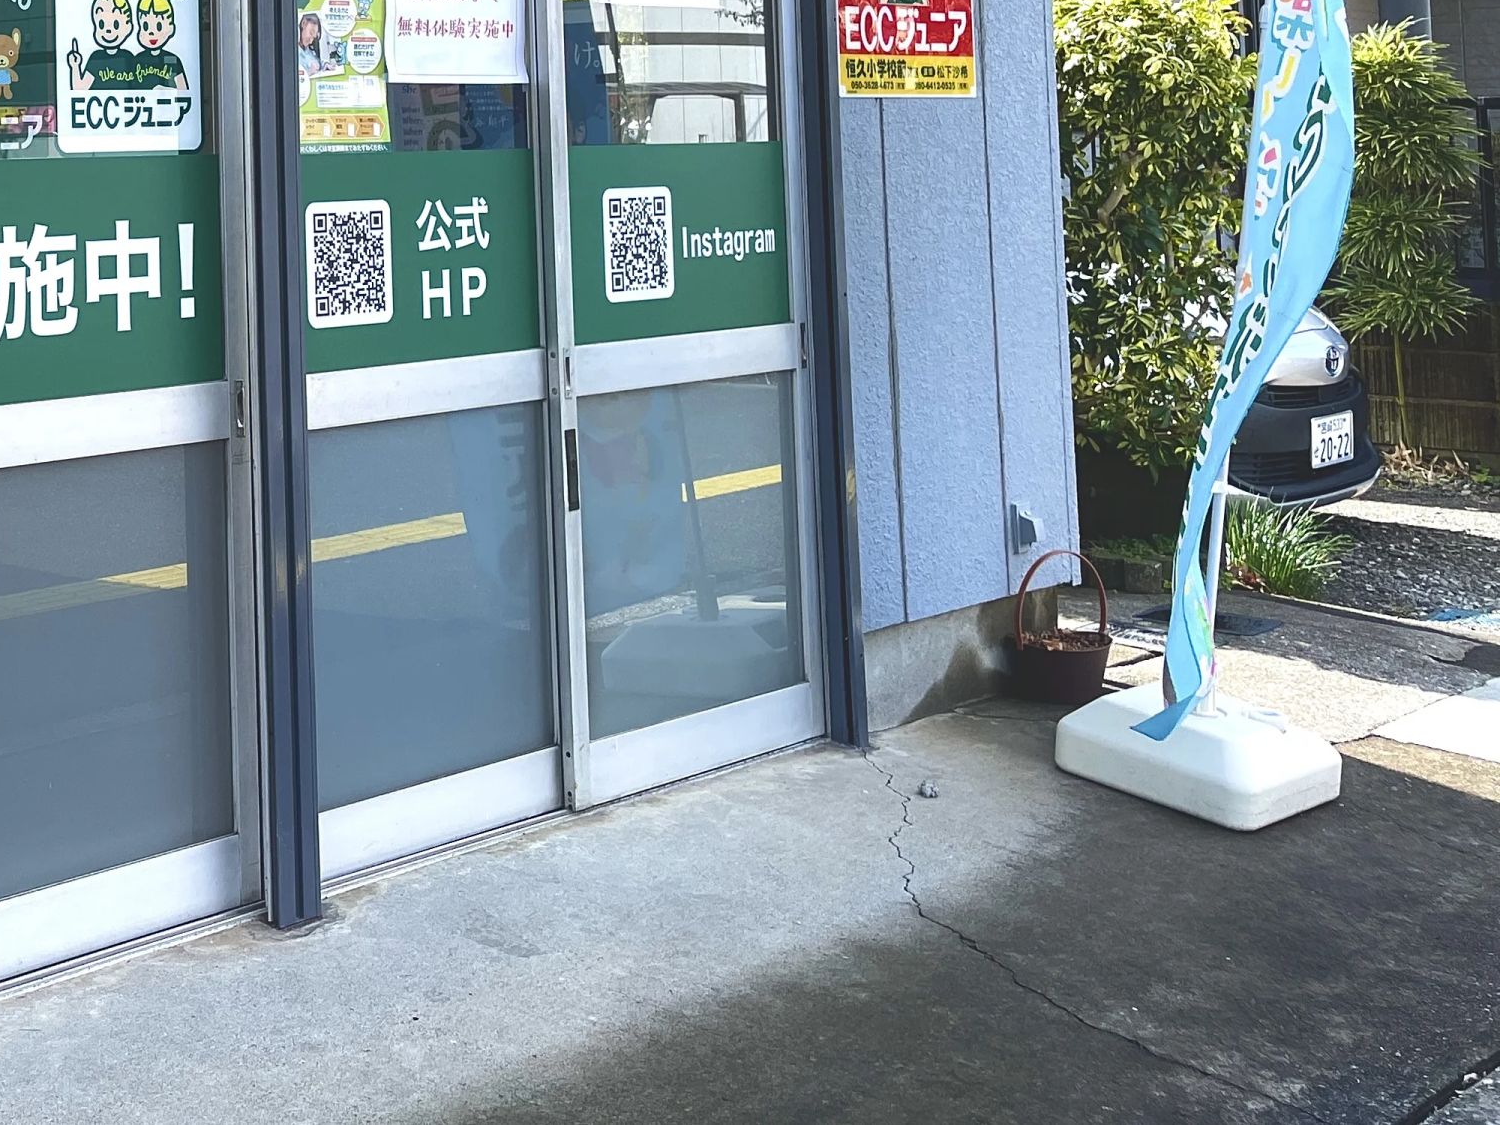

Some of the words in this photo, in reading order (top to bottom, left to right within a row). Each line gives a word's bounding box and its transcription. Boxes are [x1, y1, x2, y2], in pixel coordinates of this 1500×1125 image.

[397, 16, 515, 40] 無料体験実施中
[844, 5, 967, 53] ECCジュニア
[98, 66, 116, 83] We
[116, 71, 135, 82] are
[71, 95, 192, 129] ECCジュニア
[415, 196, 491, 253] 公式
[681, 225, 776, 262] Instagram
[420, 267, 488, 320] HP
